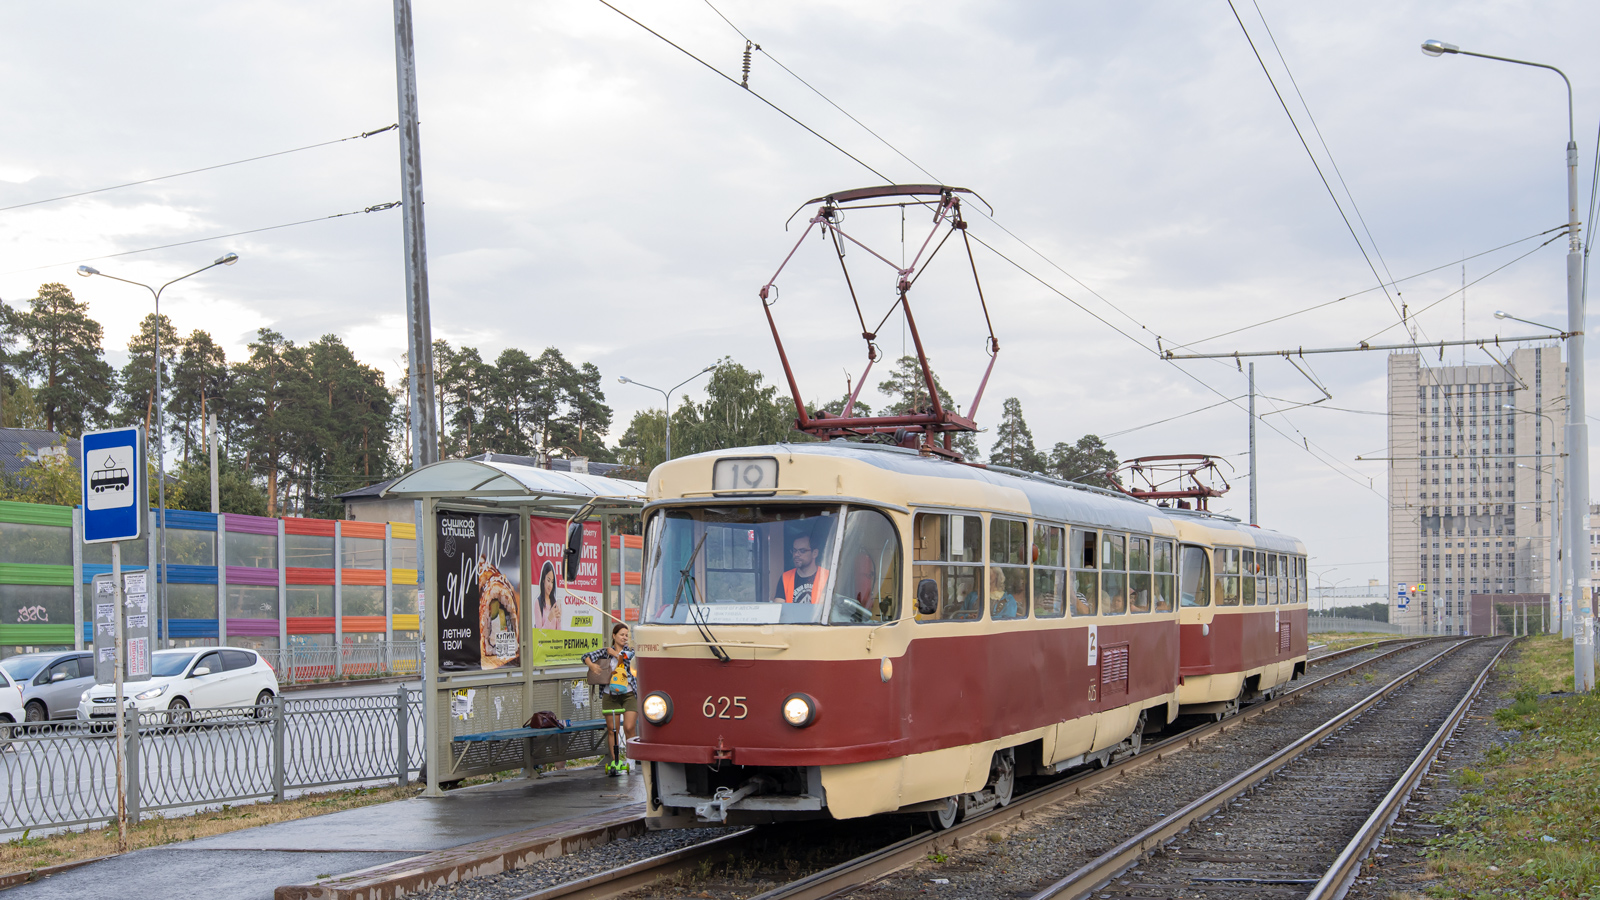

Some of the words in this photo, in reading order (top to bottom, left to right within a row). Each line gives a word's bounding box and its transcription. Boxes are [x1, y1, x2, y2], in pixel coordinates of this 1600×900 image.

[732, 464, 764, 495] 19
[441, 517, 475, 529] сушкоф
[536, 541, 598, 559] ОТПРАЙТЕ
[574, 617, 591, 626] ДРУЖБА
[442, 628, 472, 639] летние
[495, 632, 515, 640] КУПИМ
[591, 637, 598, 648] 94
[1089, 632, 1096, 652] 2
[1087, 684, 1097, 701] 625
[702, 695, 748, 720] 625
